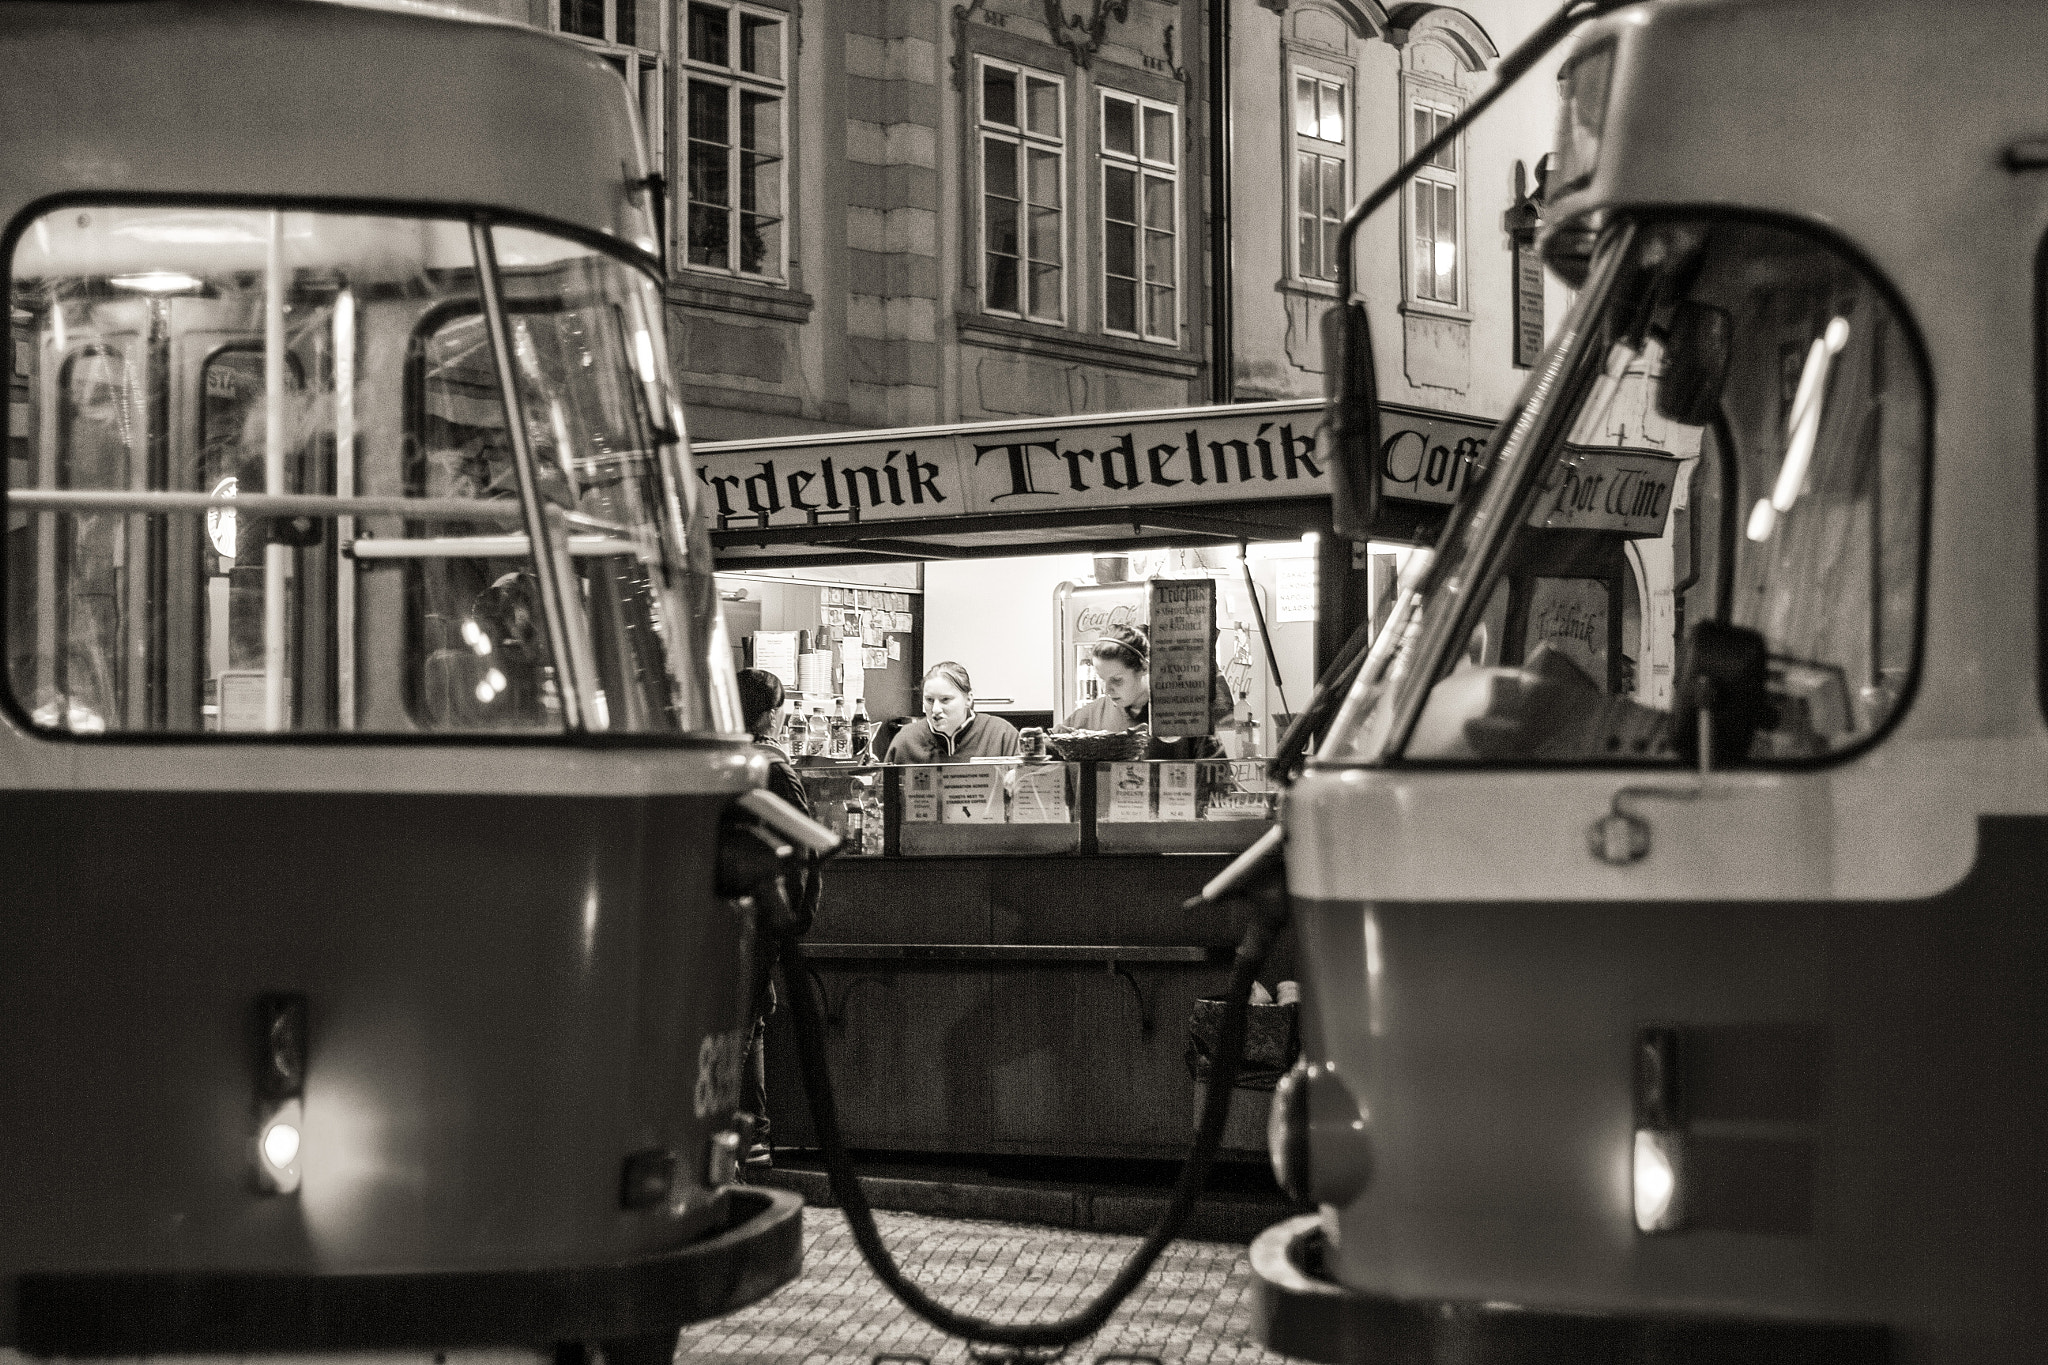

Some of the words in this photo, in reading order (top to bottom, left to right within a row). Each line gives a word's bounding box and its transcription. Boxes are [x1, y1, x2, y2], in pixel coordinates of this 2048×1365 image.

[974, 422, 1324, 503] Trdelník
[1381, 429, 1488, 493] Coff
[1605, 468, 1666, 524] Wine
